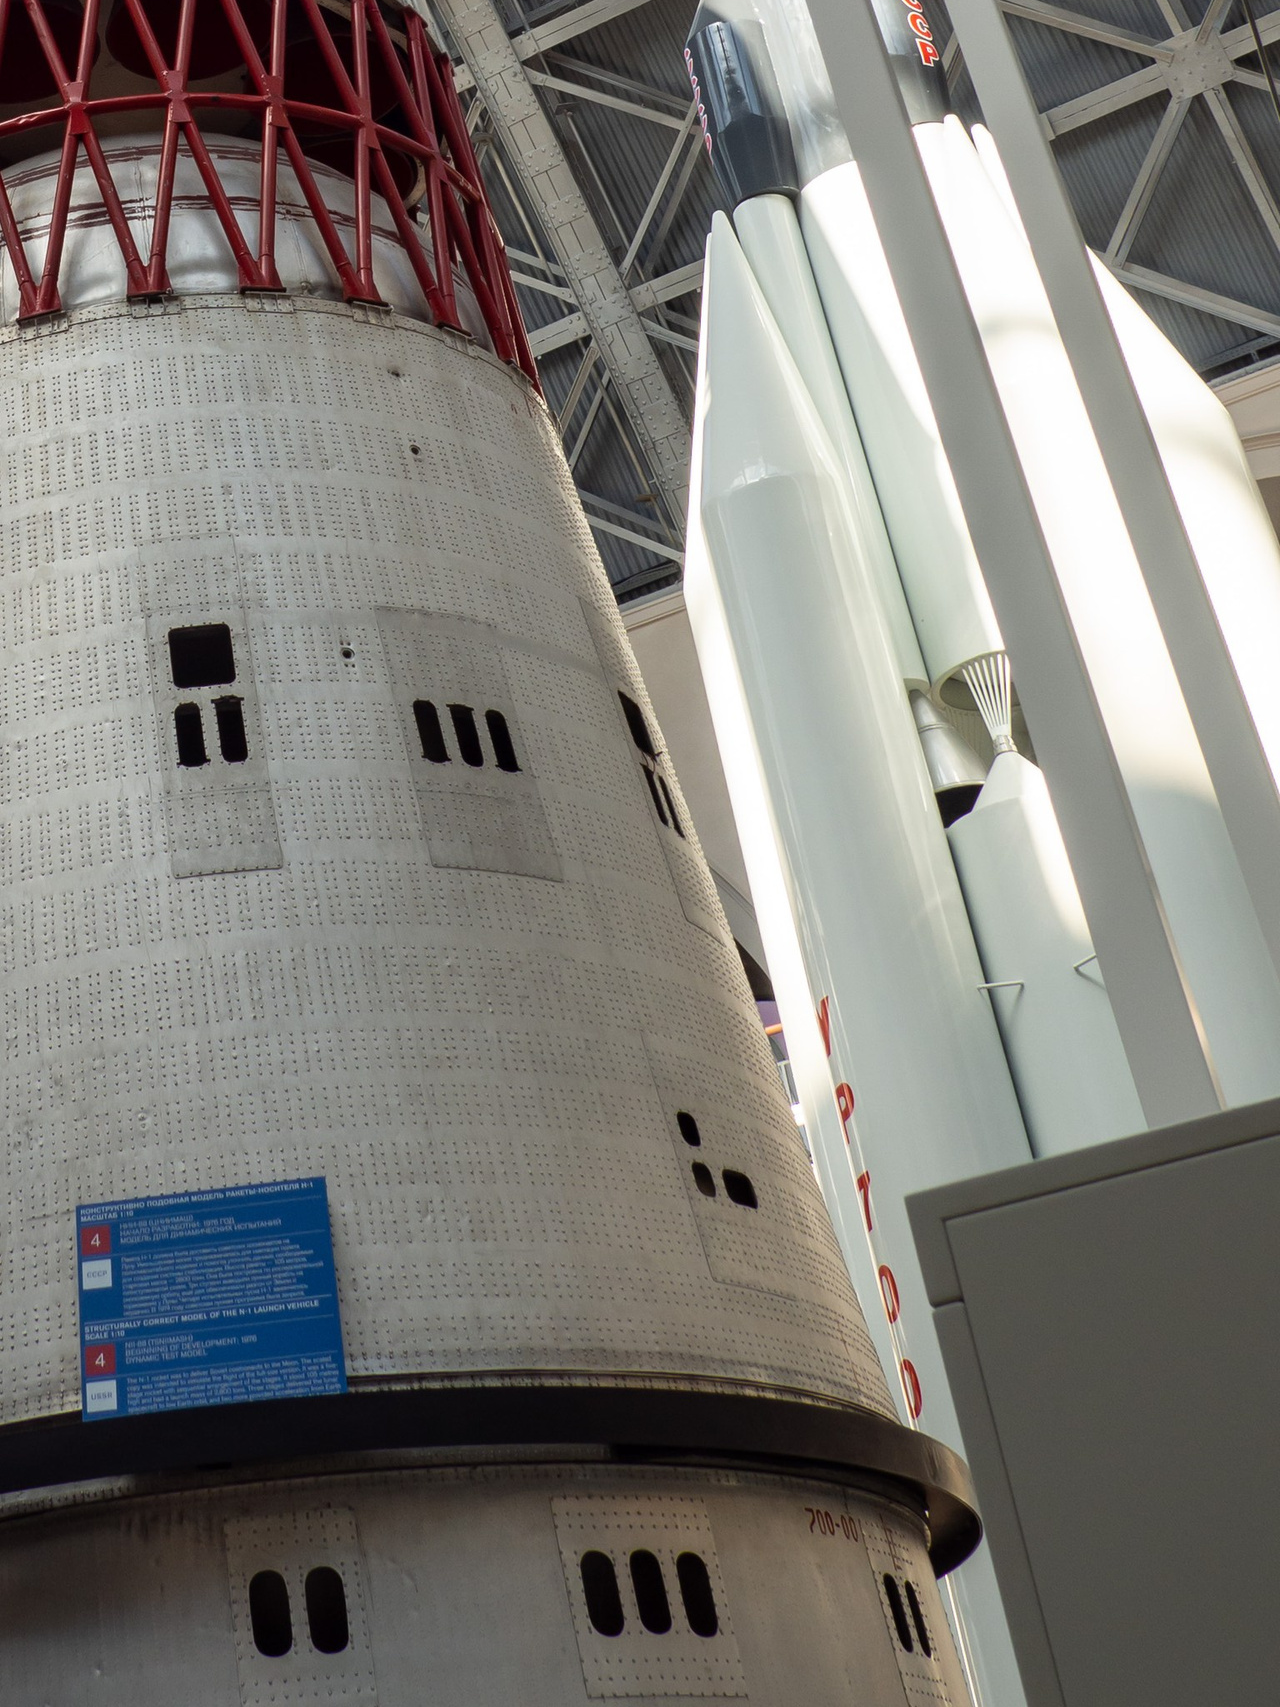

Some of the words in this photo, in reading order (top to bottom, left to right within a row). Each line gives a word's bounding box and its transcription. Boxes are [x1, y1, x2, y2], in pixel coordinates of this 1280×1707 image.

[81, 1202, 144, 1215] КОНСТРУКТИВНО
[147, 1196, 189, 1207] ПОДОБНАЯ
[191, 1192, 224, 1202] МОДЕЛЬ
[226, 1183, 299, 1198] РАКЕТЫ-НОСИТЕЛЯ
[81, 1212, 118, 1222] МАСШТАБ
[120, 1210, 134, 1218] 1:10
[120, 1234, 151, 1244] МОДЕЛЬ
[153, 1232, 168, 1240] ДЛЯ
[170, 1225, 233, 1238] ДИНАМИЧЕСКИХ
[234, 1219, 281, 1230] ИСПЫТАНИЙ
[120, 1228, 150, 1237] НАЧАЛО
[90, 1233, 101, 1248] 4
[85, 1320, 141, 1333] STRUCTURALLY
[143, 1316, 178, 1326] CORRECT
[181, 1313, 207, 1322] MODEL
[210, 1311, 219, 1319] OF
[222, 1309, 237, 1317] THE
[253, 1304, 285, 1314] LAUNCH
[287, 1300, 319, 1310] VEHICLE
[85, 1332, 108, 1340] SCALE
[125, 1346, 166, 1356] BEGINNING
[168, 1344, 180, 1352] OF
[125, 1354, 160, 1364] DYNAMIC
[162, 1352, 178, 1360] TEST
[180, 1349, 207, 1358] MODEL
[95, 1353, 105, 1368] 4
[91, 1391, 113, 1400] USSR
[804, 1507, 859, 1543] 700-00
